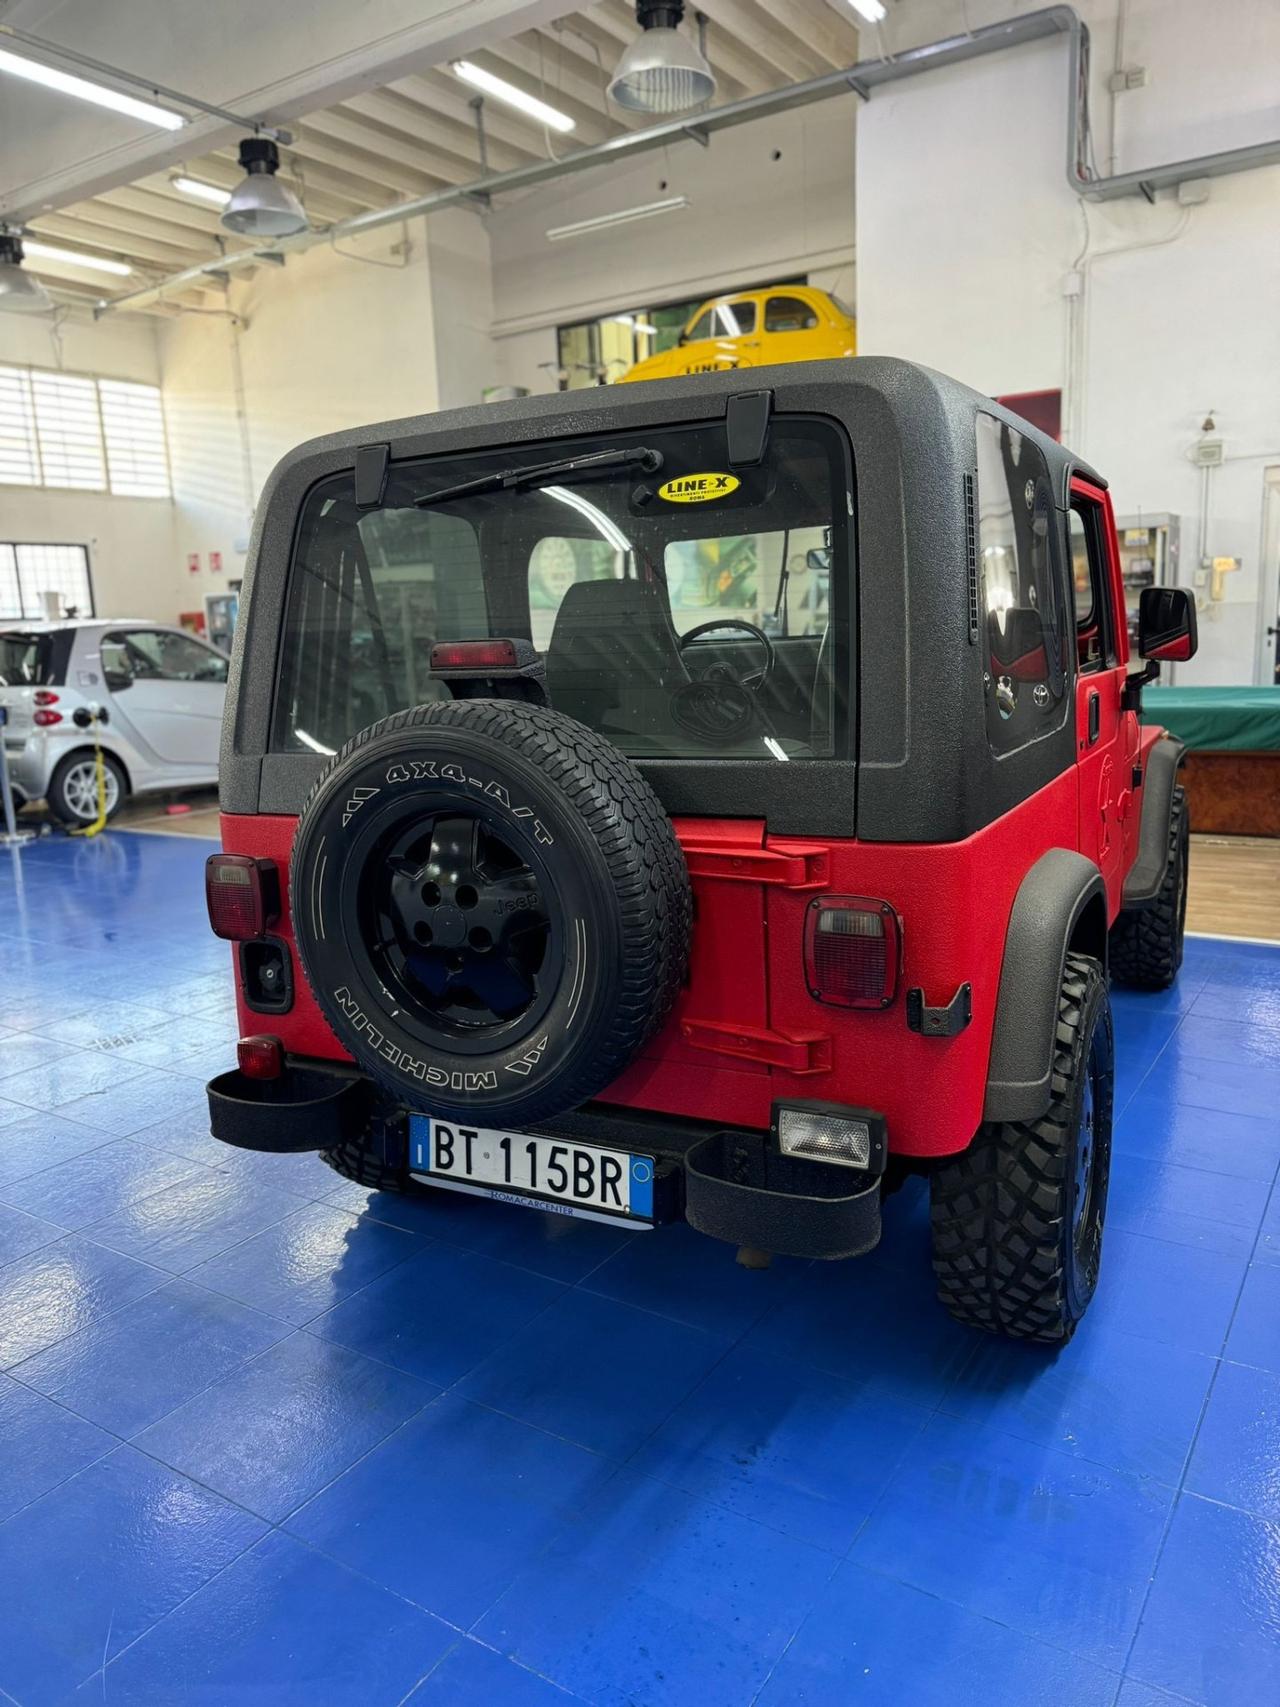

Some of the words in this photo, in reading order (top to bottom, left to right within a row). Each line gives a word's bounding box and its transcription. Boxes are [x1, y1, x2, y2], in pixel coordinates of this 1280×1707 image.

[494, 892, 538, 915] Jeep
[334, 986, 498, 1091] MICHELIN
[434, 1125, 478, 1175] BT
[499, 1137, 623, 1206] 115BR
